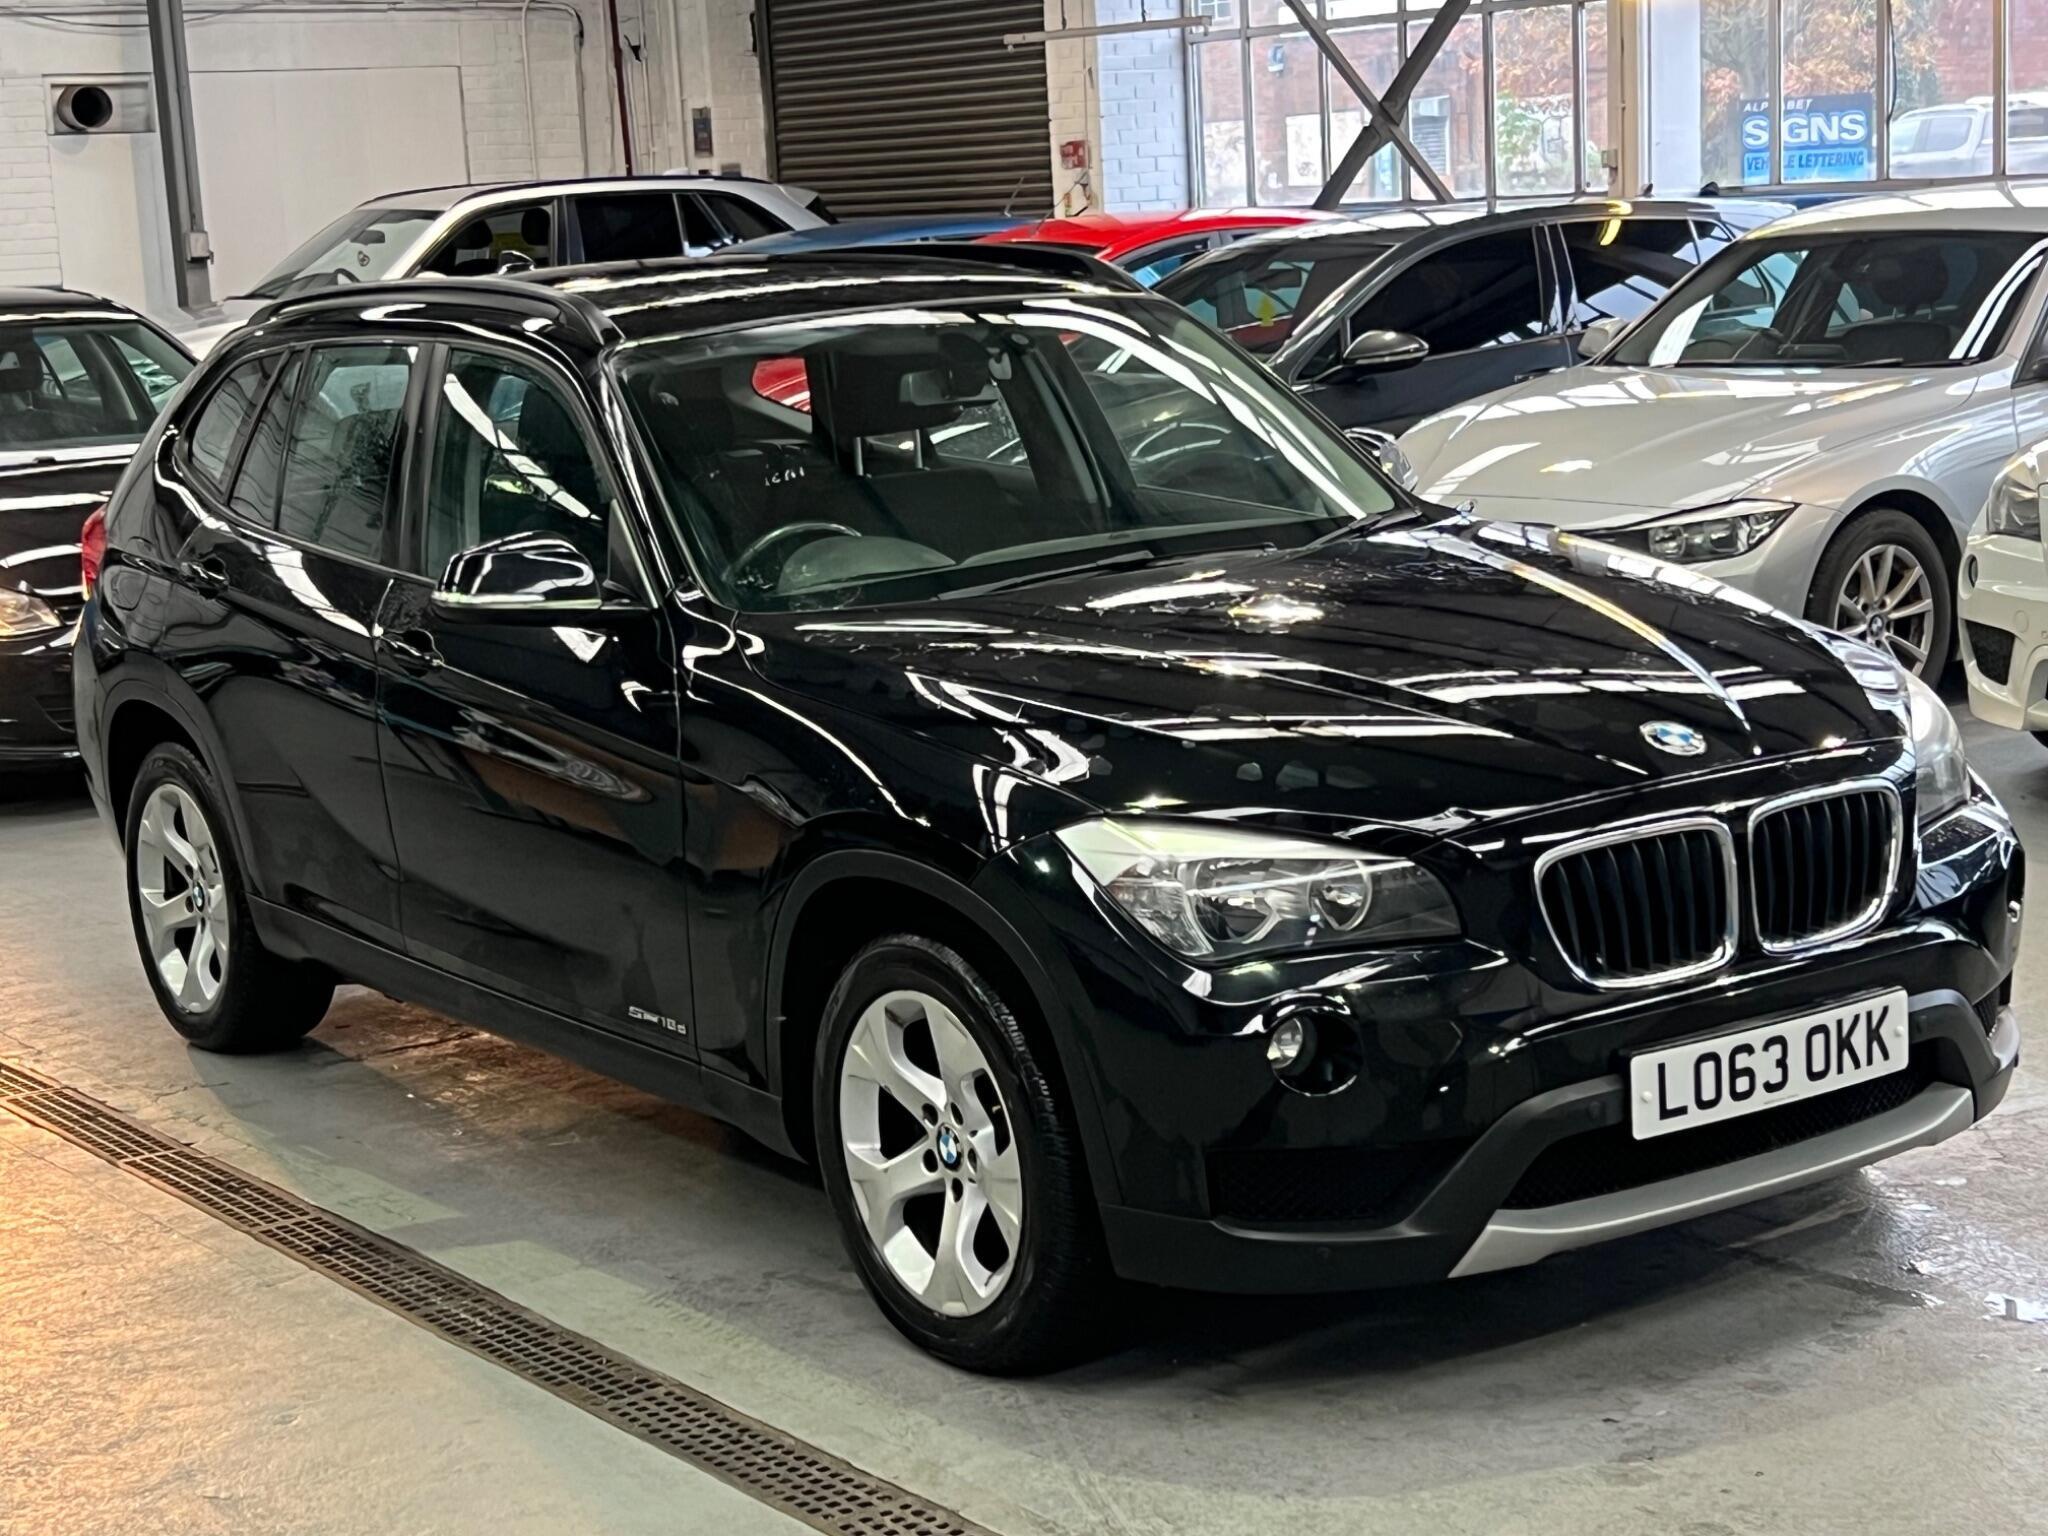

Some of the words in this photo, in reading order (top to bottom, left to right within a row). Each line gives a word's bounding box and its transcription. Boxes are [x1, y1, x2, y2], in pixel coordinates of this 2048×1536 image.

[1743, 99, 1813, 112] ALPBET
[1743, 113, 1866, 147] SGNS
[1798, 151, 1864, 169] LETTERING
[1657, 1034, 1789, 1120] LO63
[1805, 1005, 1890, 1083] OKK
